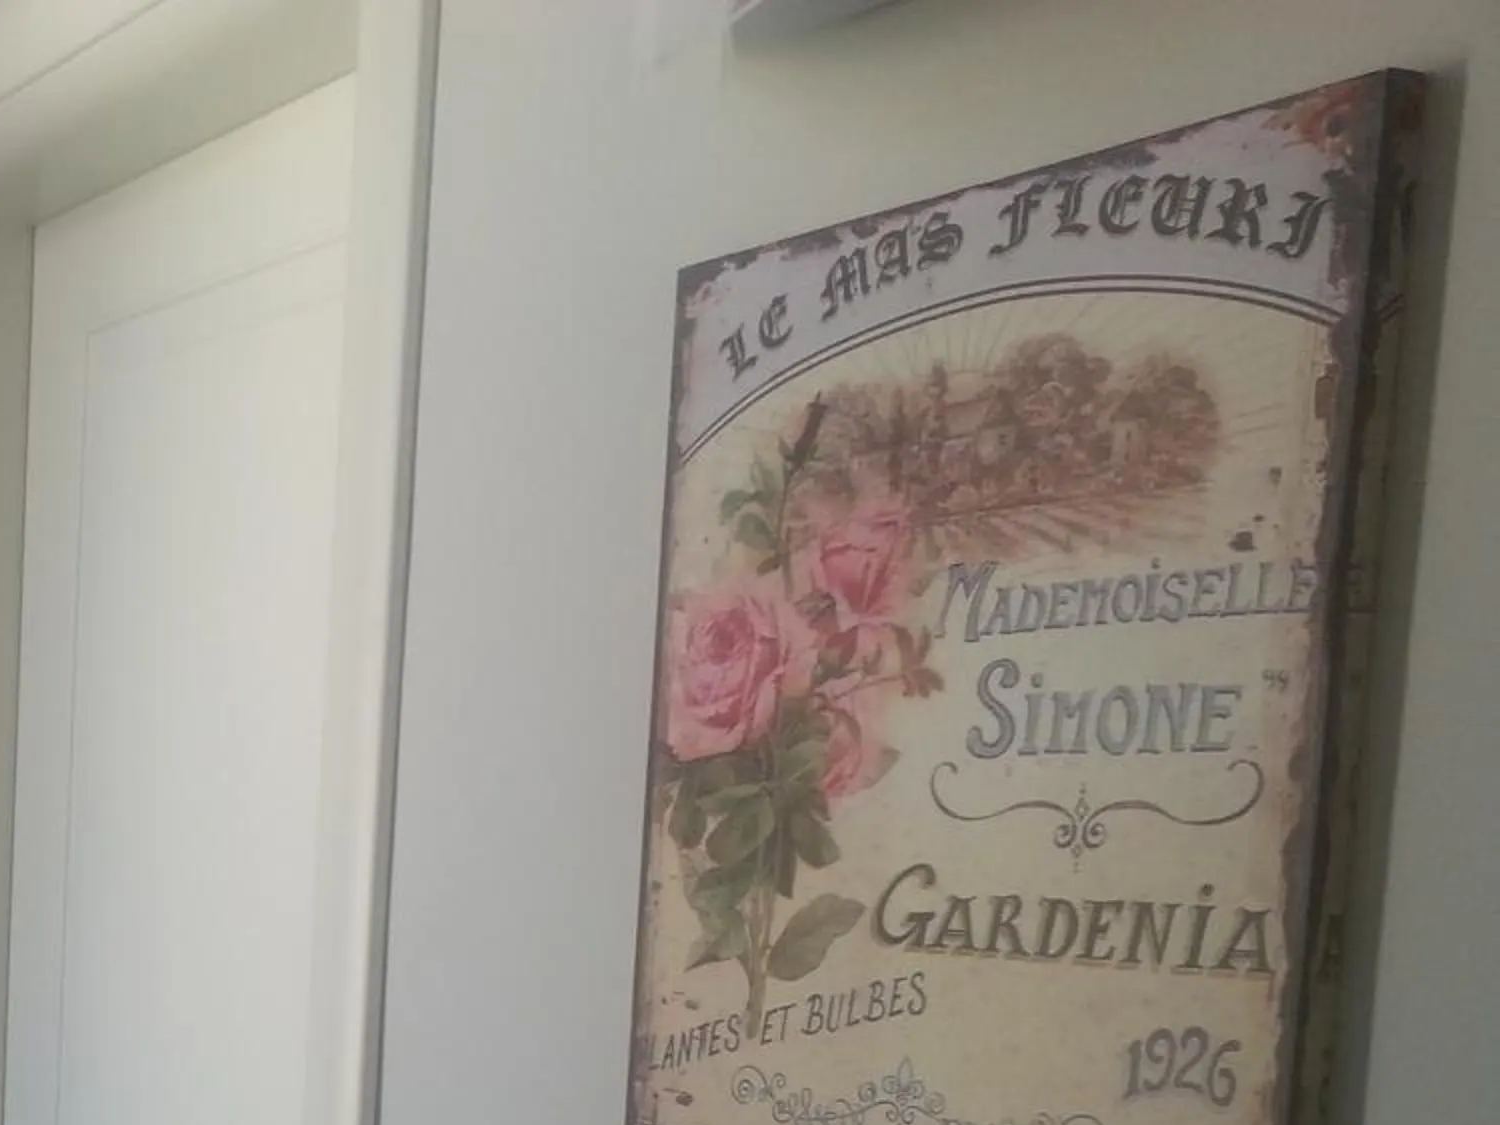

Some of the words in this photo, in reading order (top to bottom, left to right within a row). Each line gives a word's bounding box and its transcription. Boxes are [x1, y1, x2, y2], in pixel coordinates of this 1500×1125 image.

[719, 295, 794, 381] LE
[820, 210, 965, 322] MAS
[988, 172, 1333, 259] FLEURI
[759, 1002, 798, 1047] ET
[800, 970, 928, 1036] BULBES
[1121, 1025, 1243, 1107] 1926
